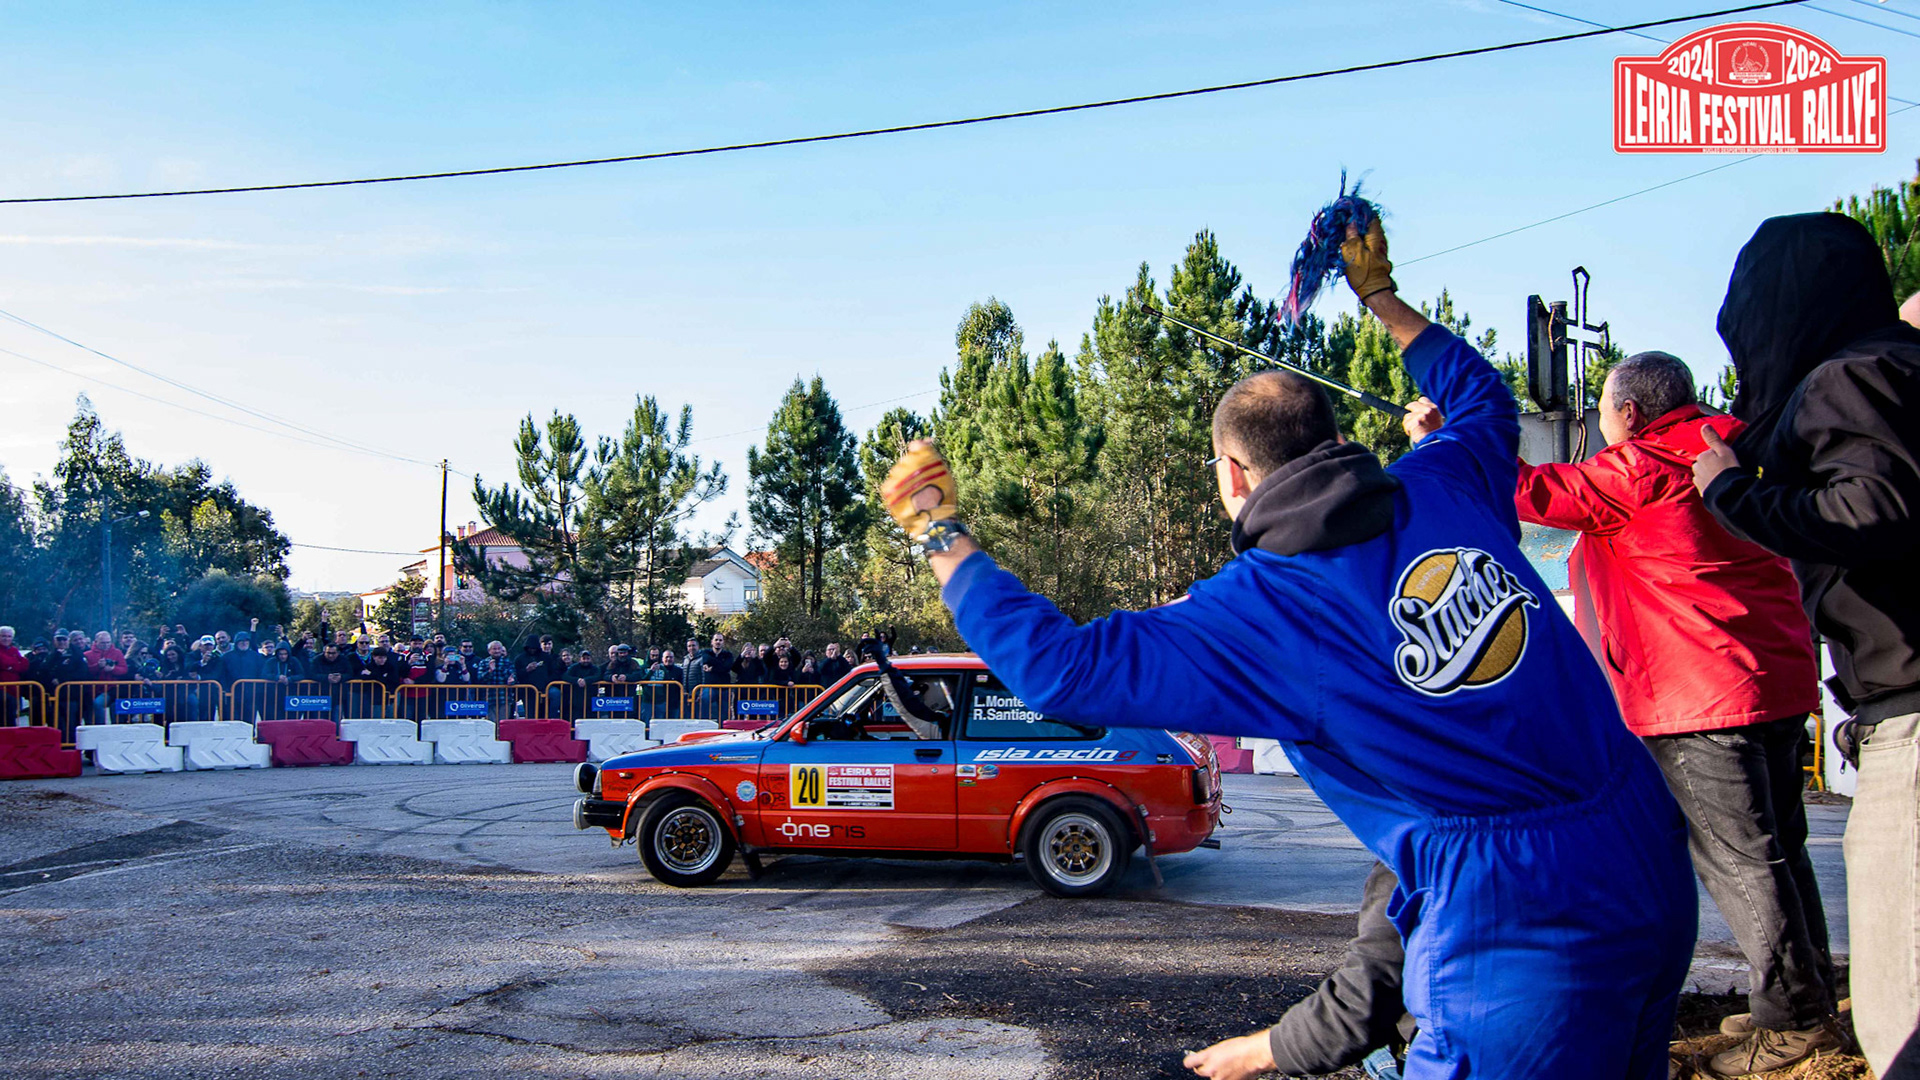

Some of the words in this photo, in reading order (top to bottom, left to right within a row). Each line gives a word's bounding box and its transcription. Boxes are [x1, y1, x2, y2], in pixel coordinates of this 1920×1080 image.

[973, 709, 1043, 723] R.Santiago
[975, 747, 1031, 760] isla
[1034, 747, 1140, 762] racing
[840, 768, 872, 776] LEIRIA
[798, 767, 818, 804] 20
[829, 777, 862, 786] FESTIVAL
[864, 777, 891, 787] RALLYE
